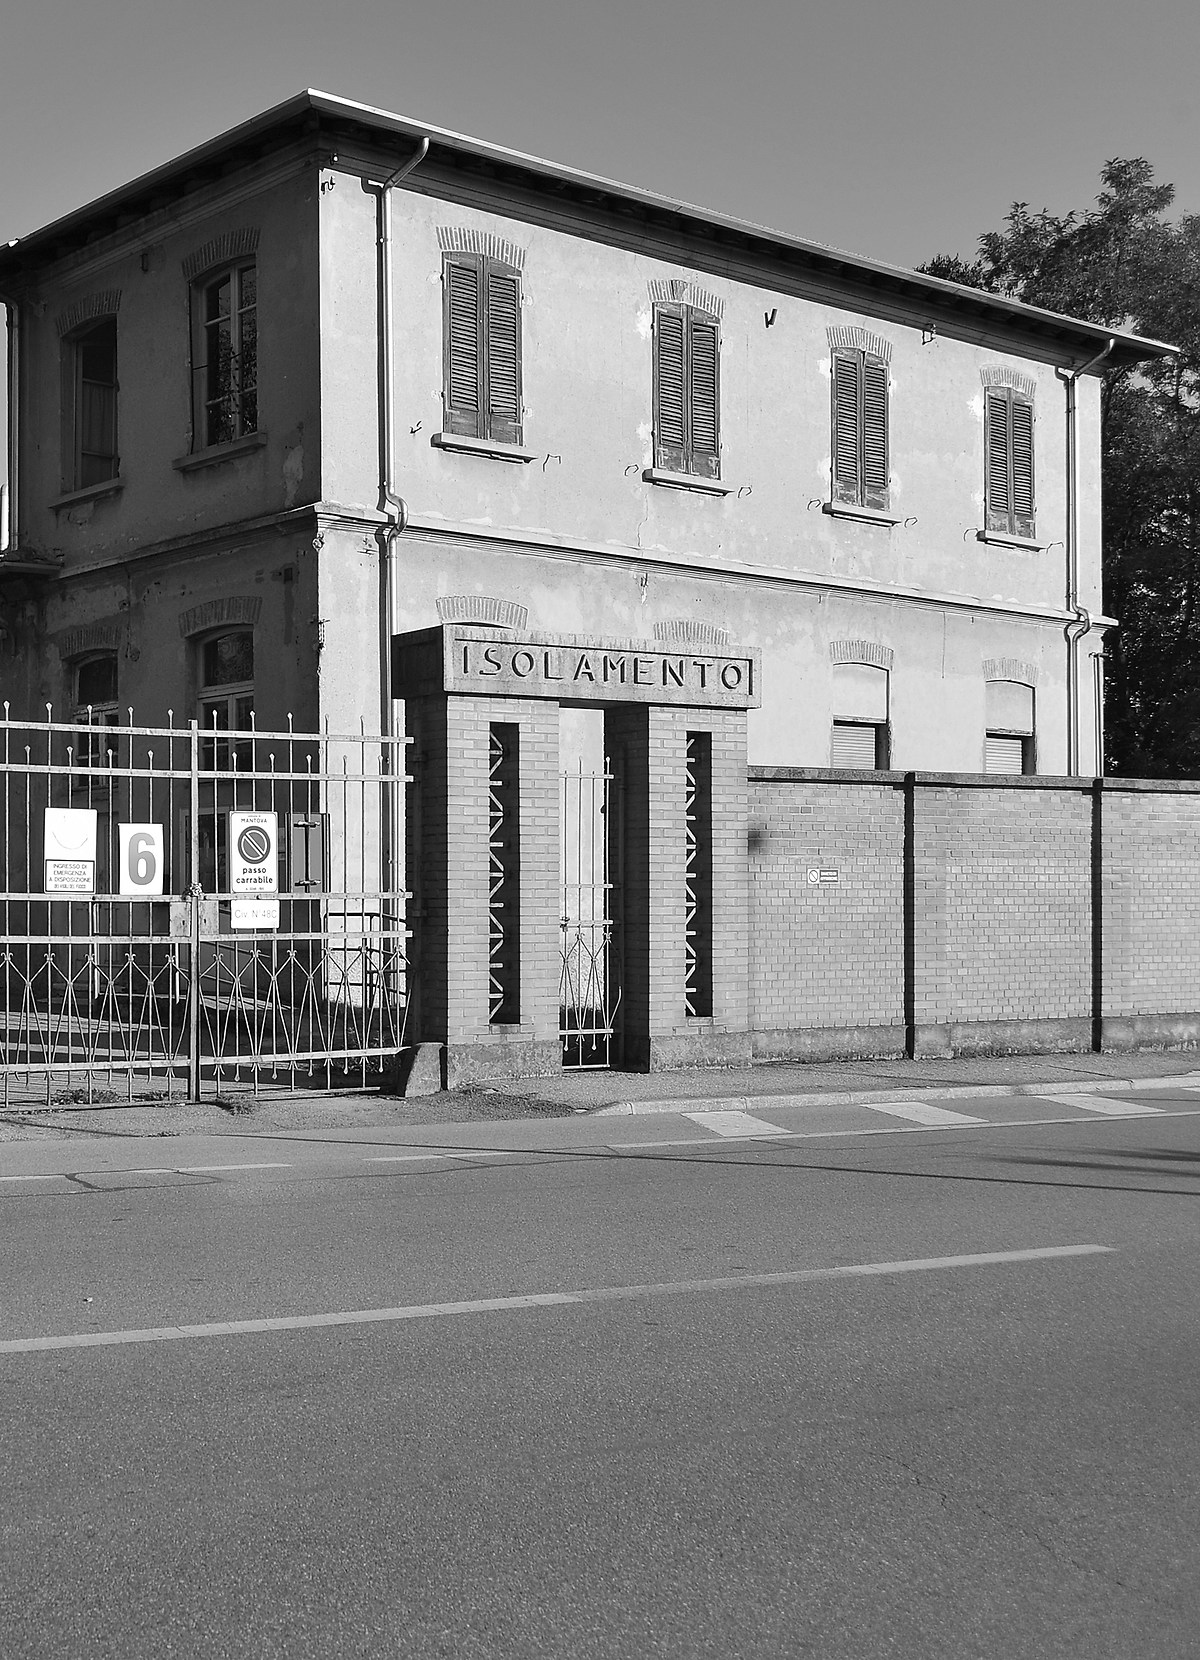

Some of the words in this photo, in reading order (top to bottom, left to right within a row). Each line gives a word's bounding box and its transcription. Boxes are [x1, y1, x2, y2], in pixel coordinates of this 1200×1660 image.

[462, 645, 743, 690] ISOLAMENTO
[128, 832, 156, 885] 6
[242, 867, 267, 875] passo
[236, 876, 273, 884] carrabile
